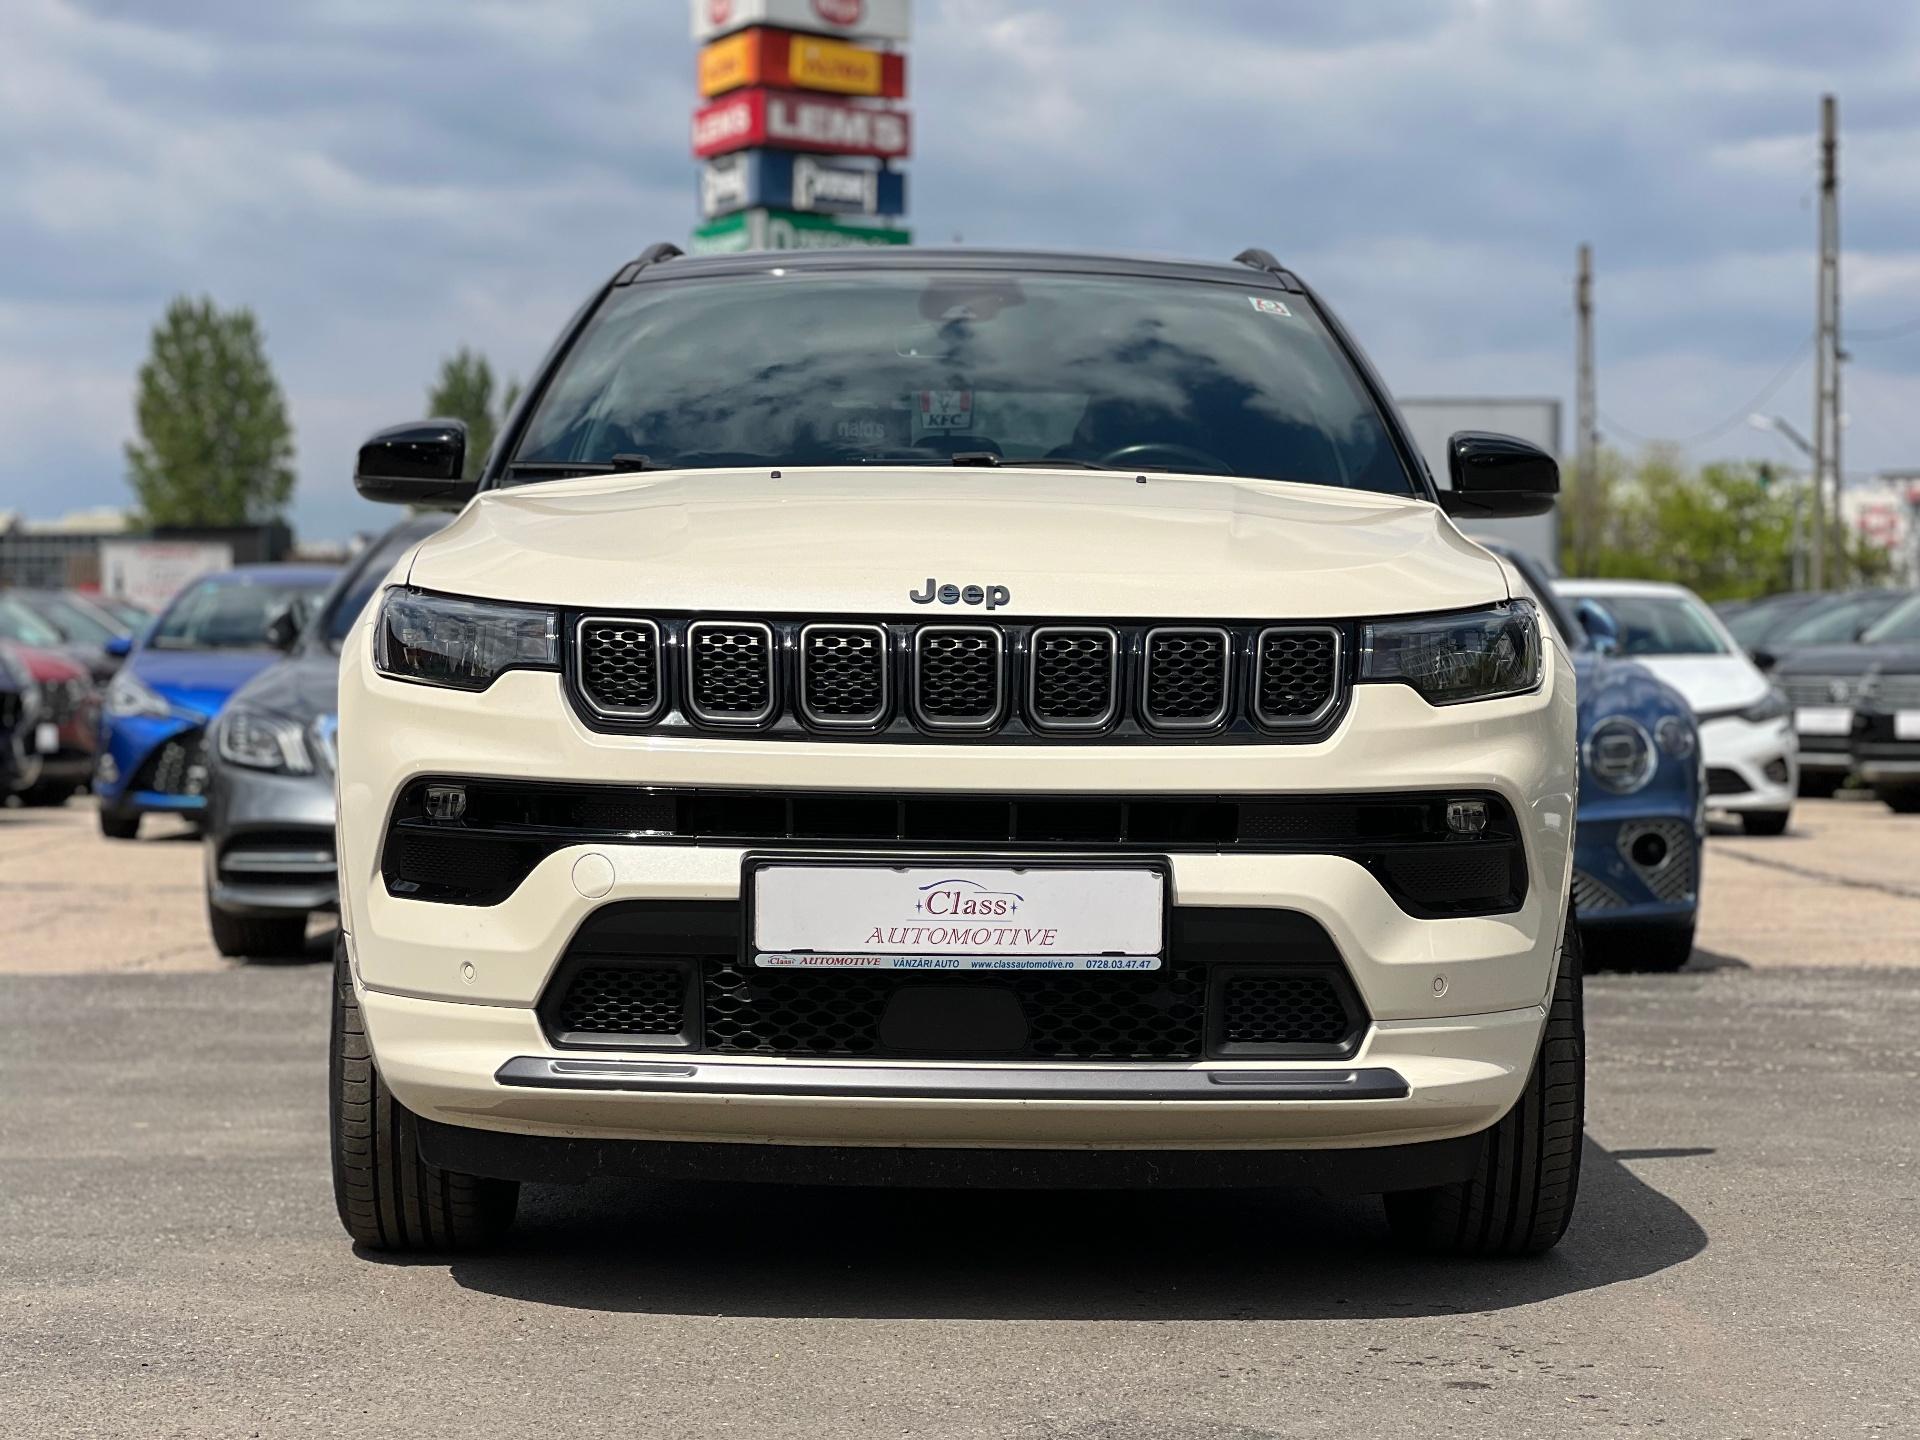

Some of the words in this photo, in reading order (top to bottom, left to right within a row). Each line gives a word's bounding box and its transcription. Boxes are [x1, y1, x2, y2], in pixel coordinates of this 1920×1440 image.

[769, 99, 905, 152] LEMS
[928, 414, 962, 426] KFC
[909, 578, 1010, 610] Jeep
[925, 891, 1008, 915] Class
[864, 927, 1057, 946] AUTOMOTIVE
[769, 957, 792, 965] Class
[800, 957, 881, 966] AUTOMOTIVE
[934, 959, 960, 968] AUTO
[971, 960, 1074, 969] www.classautomotive.ro
[1086, 959, 1151, 969] 0728.03.47.47
